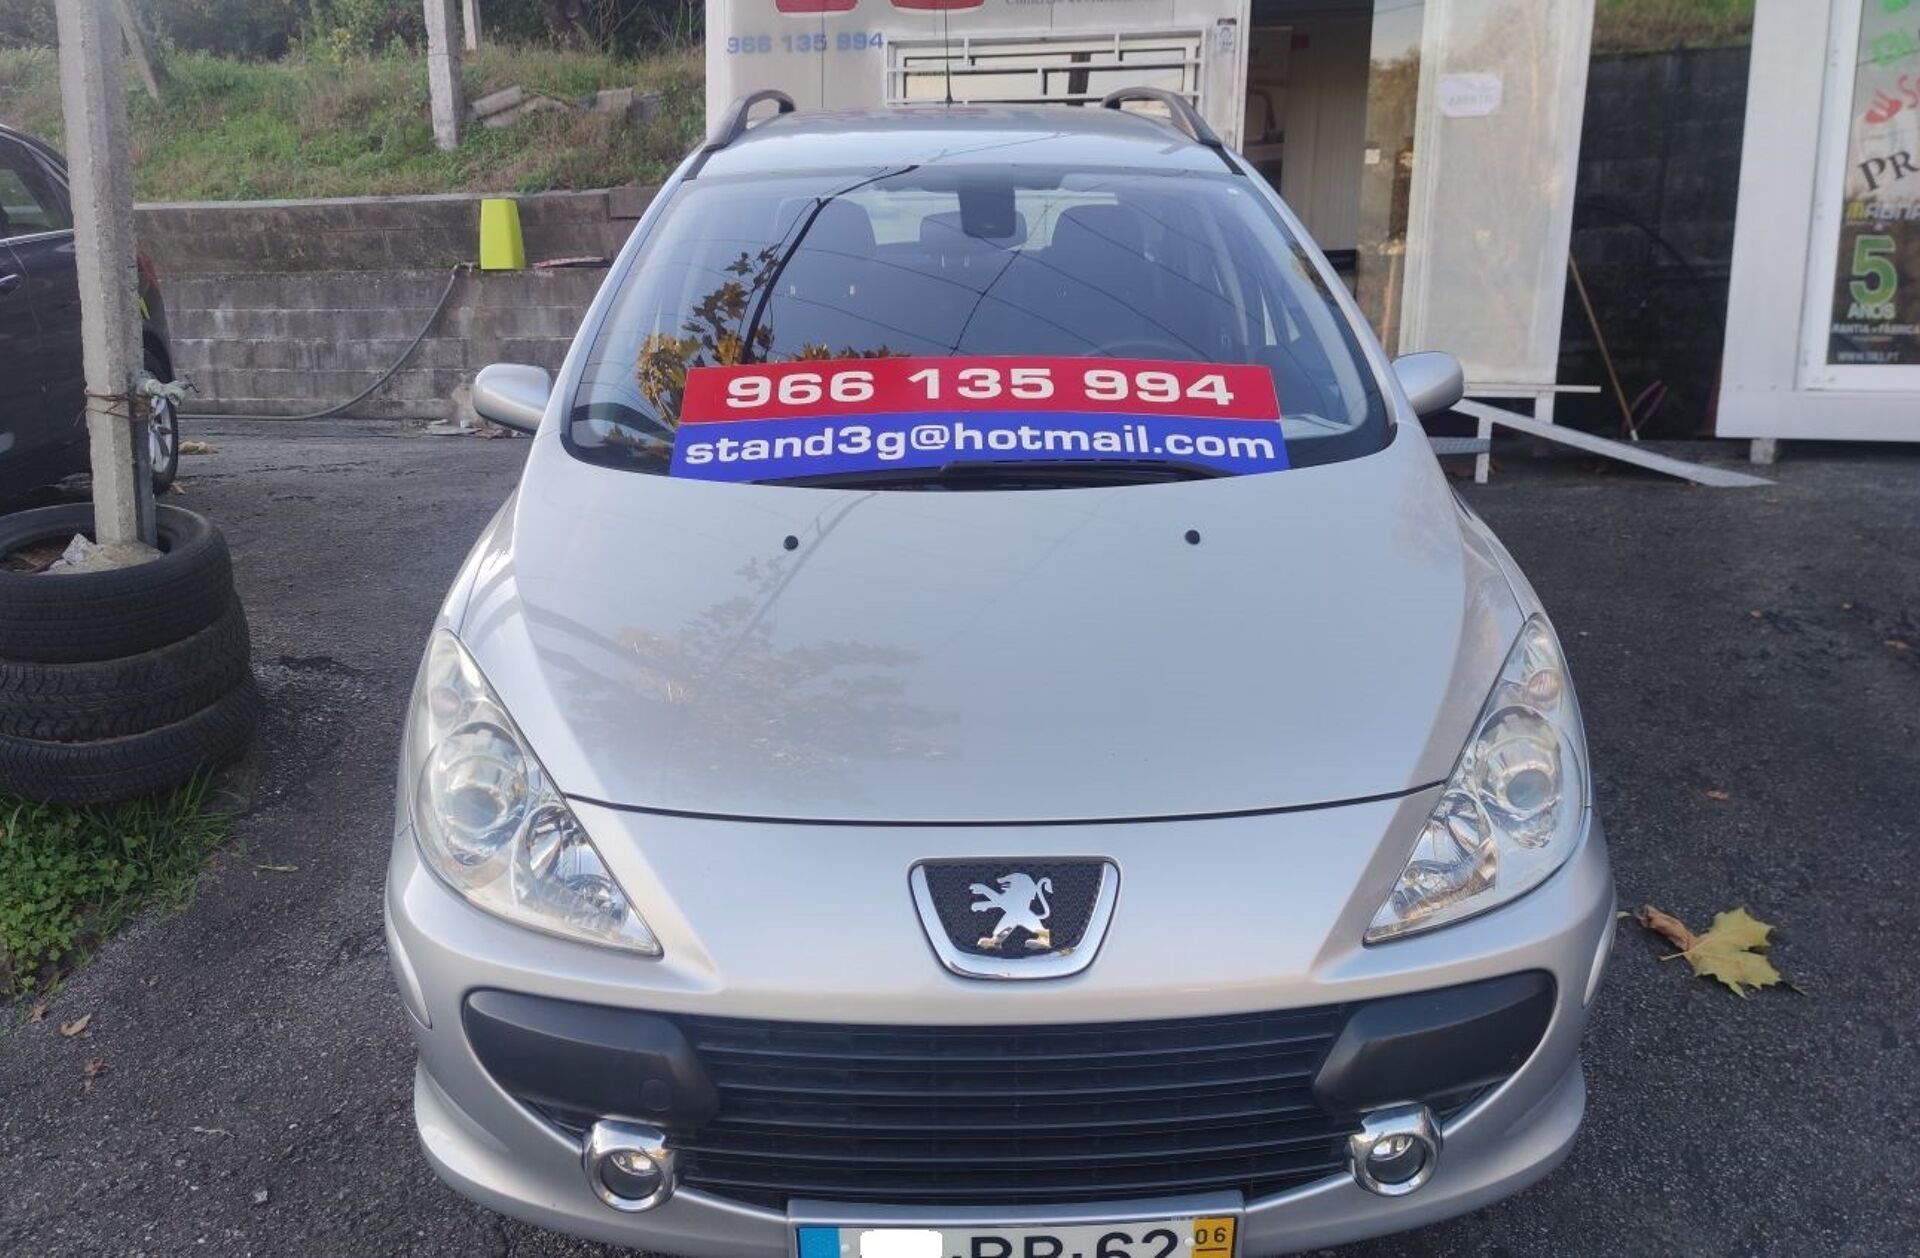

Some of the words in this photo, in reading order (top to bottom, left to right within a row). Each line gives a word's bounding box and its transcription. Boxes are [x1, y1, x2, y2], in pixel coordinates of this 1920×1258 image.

[1849, 234, 1898, 305] 5
[725, 371, 875, 408] 966
[907, 368, 1054, 401] 135
[1083, 370, 1234, 405] 994
[685, 422, 1276, 461] stand3g@hotmail.com
[1195, 1227, 1228, 1245] 06
